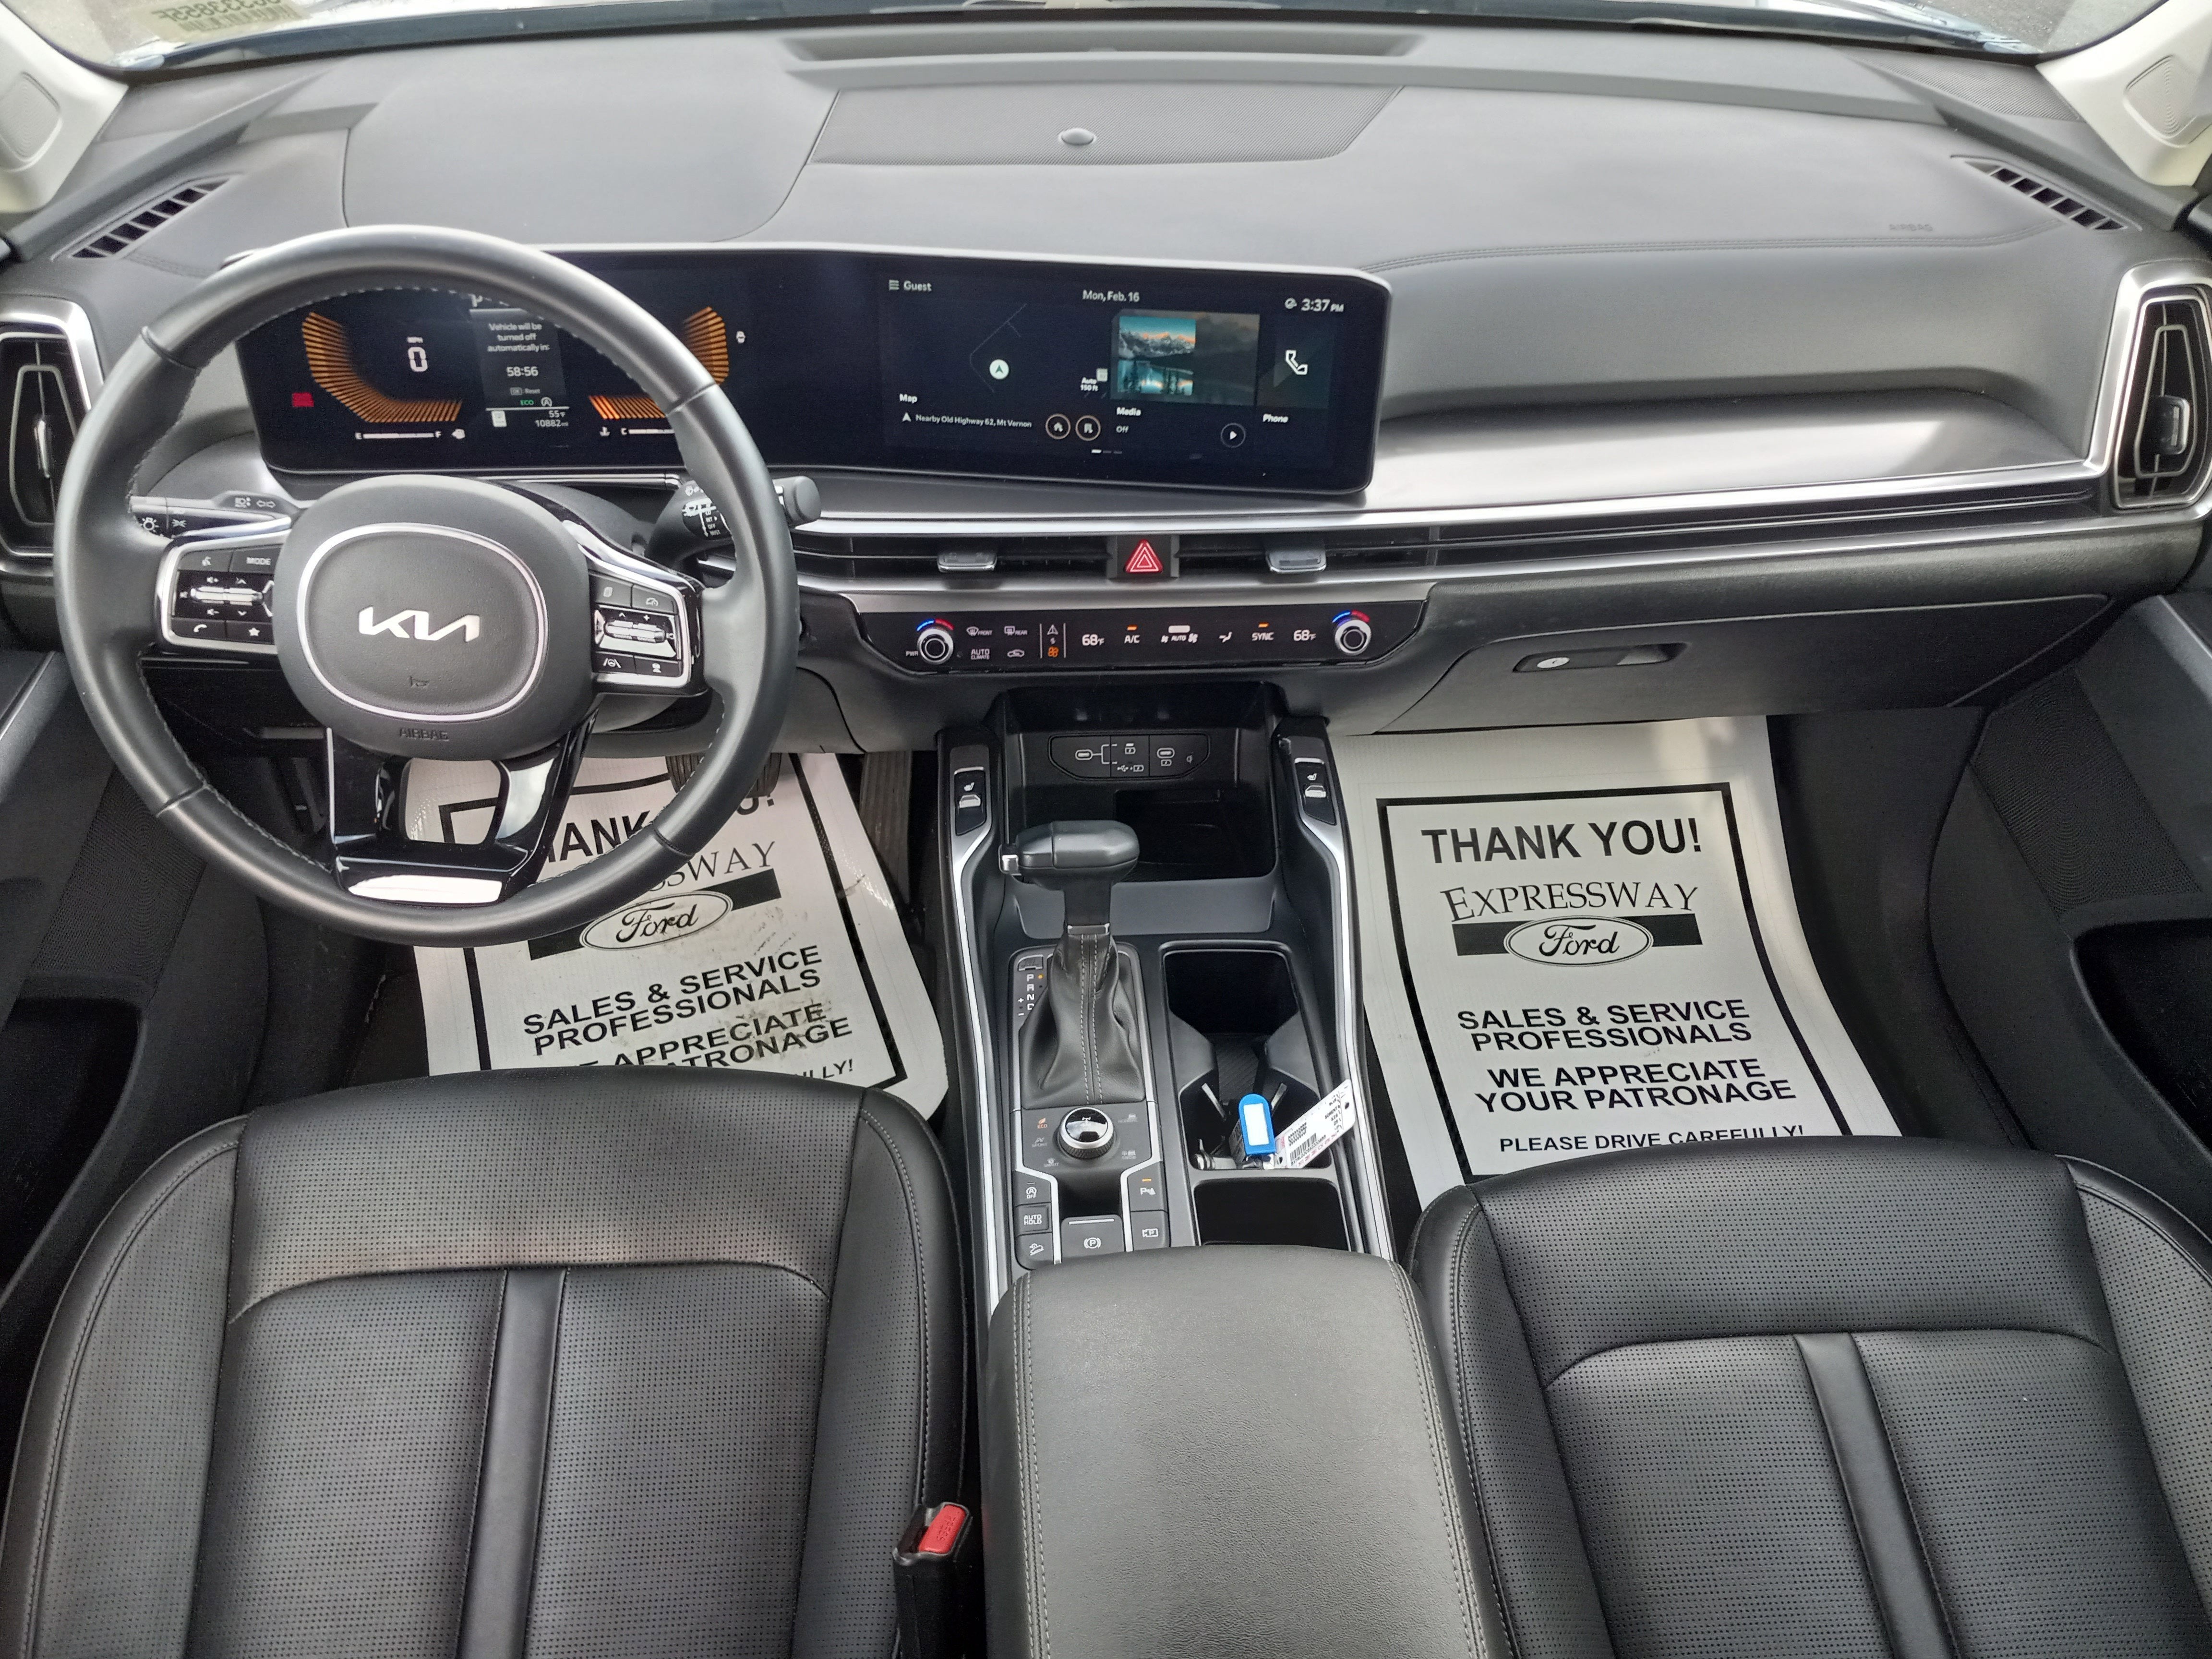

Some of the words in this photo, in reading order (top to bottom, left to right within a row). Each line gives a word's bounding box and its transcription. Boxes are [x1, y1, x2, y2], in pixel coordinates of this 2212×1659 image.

[903, 281, 932, 292] Guest
[1082, 290, 1106, 302] Mon,
[1107, 291, 1127, 301] Feb.
[1128, 292, 1140, 302] 16
[1300, 299, 1329, 312] 3:37
[1331, 303, 1344, 312] PM
[487, 344, 539, 352] automatically
[408, 347, 428, 372] 0
[506, 366, 539, 377] 58:56
[899, 394, 918, 404] Map
[1116, 407, 1141, 416] Media
[1262, 413, 1288, 423] Phone
[535, 419, 561, 427] 10882
[915, 415, 940, 424] Nearby
[954, 417, 984, 427] Highway
[985, 419, 997, 428] 62,
[247, 556, 271, 566] MODE
[1124, 635, 1140, 644] A/C
[1252, 632, 1274, 641] SYNC
[399, 728, 449, 741] AIRBAG
[546, 809, 650, 864] ANK
[1421, 824, 1582, 864] THANK
[1588, 817, 1701, 856] YOU!
[615, 902, 698, 943] Ford
[1539, 924, 1620, 956] Ford
[523, 991, 636, 1034] SALES
[648, 983, 671, 1003] &
[680, 945, 822, 995] SERVICE
[534, 969, 821, 1056] PROFESSIONALS
[1457, 1008, 1566, 1029] SALES
[1577, 1007, 1600, 1025] &
[1607, 999, 1750, 1024] SERVICE
[615, 1003, 826, 1066] APPRECIATE
[668, 1017, 853, 1068] TRONAGE
[1471, 1022, 1752, 1051] PROFESSIONALS
[1487, 1067, 1545, 1088] WE
[1555, 1058, 1766, 1087] APPRECIATE
[1475, 1090, 1579, 1113] YOUR
[1584, 1080, 1796, 1109] PATRONAGE
[1500, 1136, 1588, 1152] PLEASE
[1595, 1133, 1660, 1149] DRIVE
